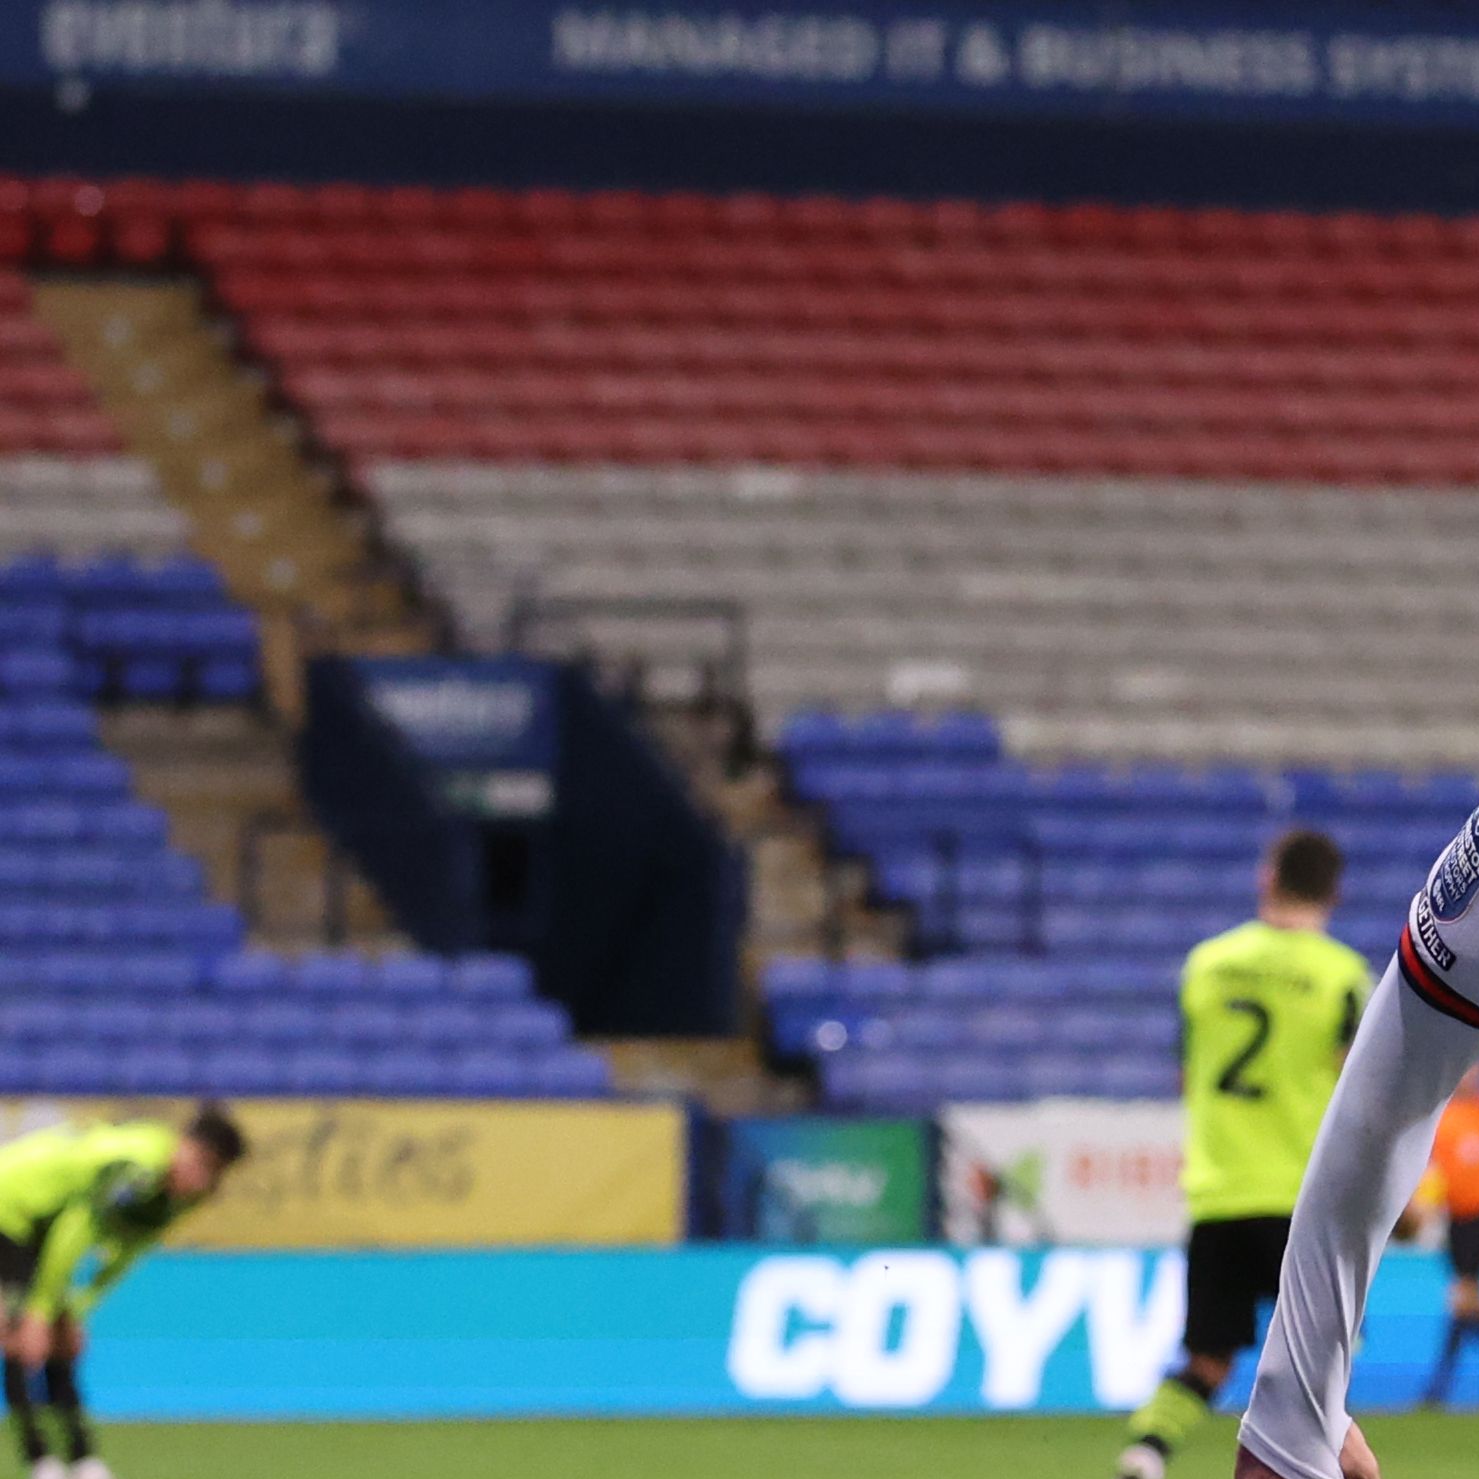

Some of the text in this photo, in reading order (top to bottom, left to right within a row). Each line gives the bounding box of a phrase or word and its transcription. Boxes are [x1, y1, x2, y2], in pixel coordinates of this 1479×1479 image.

[554, 13, 876, 82] MANAGED
[885, 20, 945, 84] IT
[957, 22, 1006, 87] &
[1018, 24, 1317, 96] BUSINESS
[1418, 892, 1452, 967] GETHER
[1216, 997, 1271, 1099] 2
